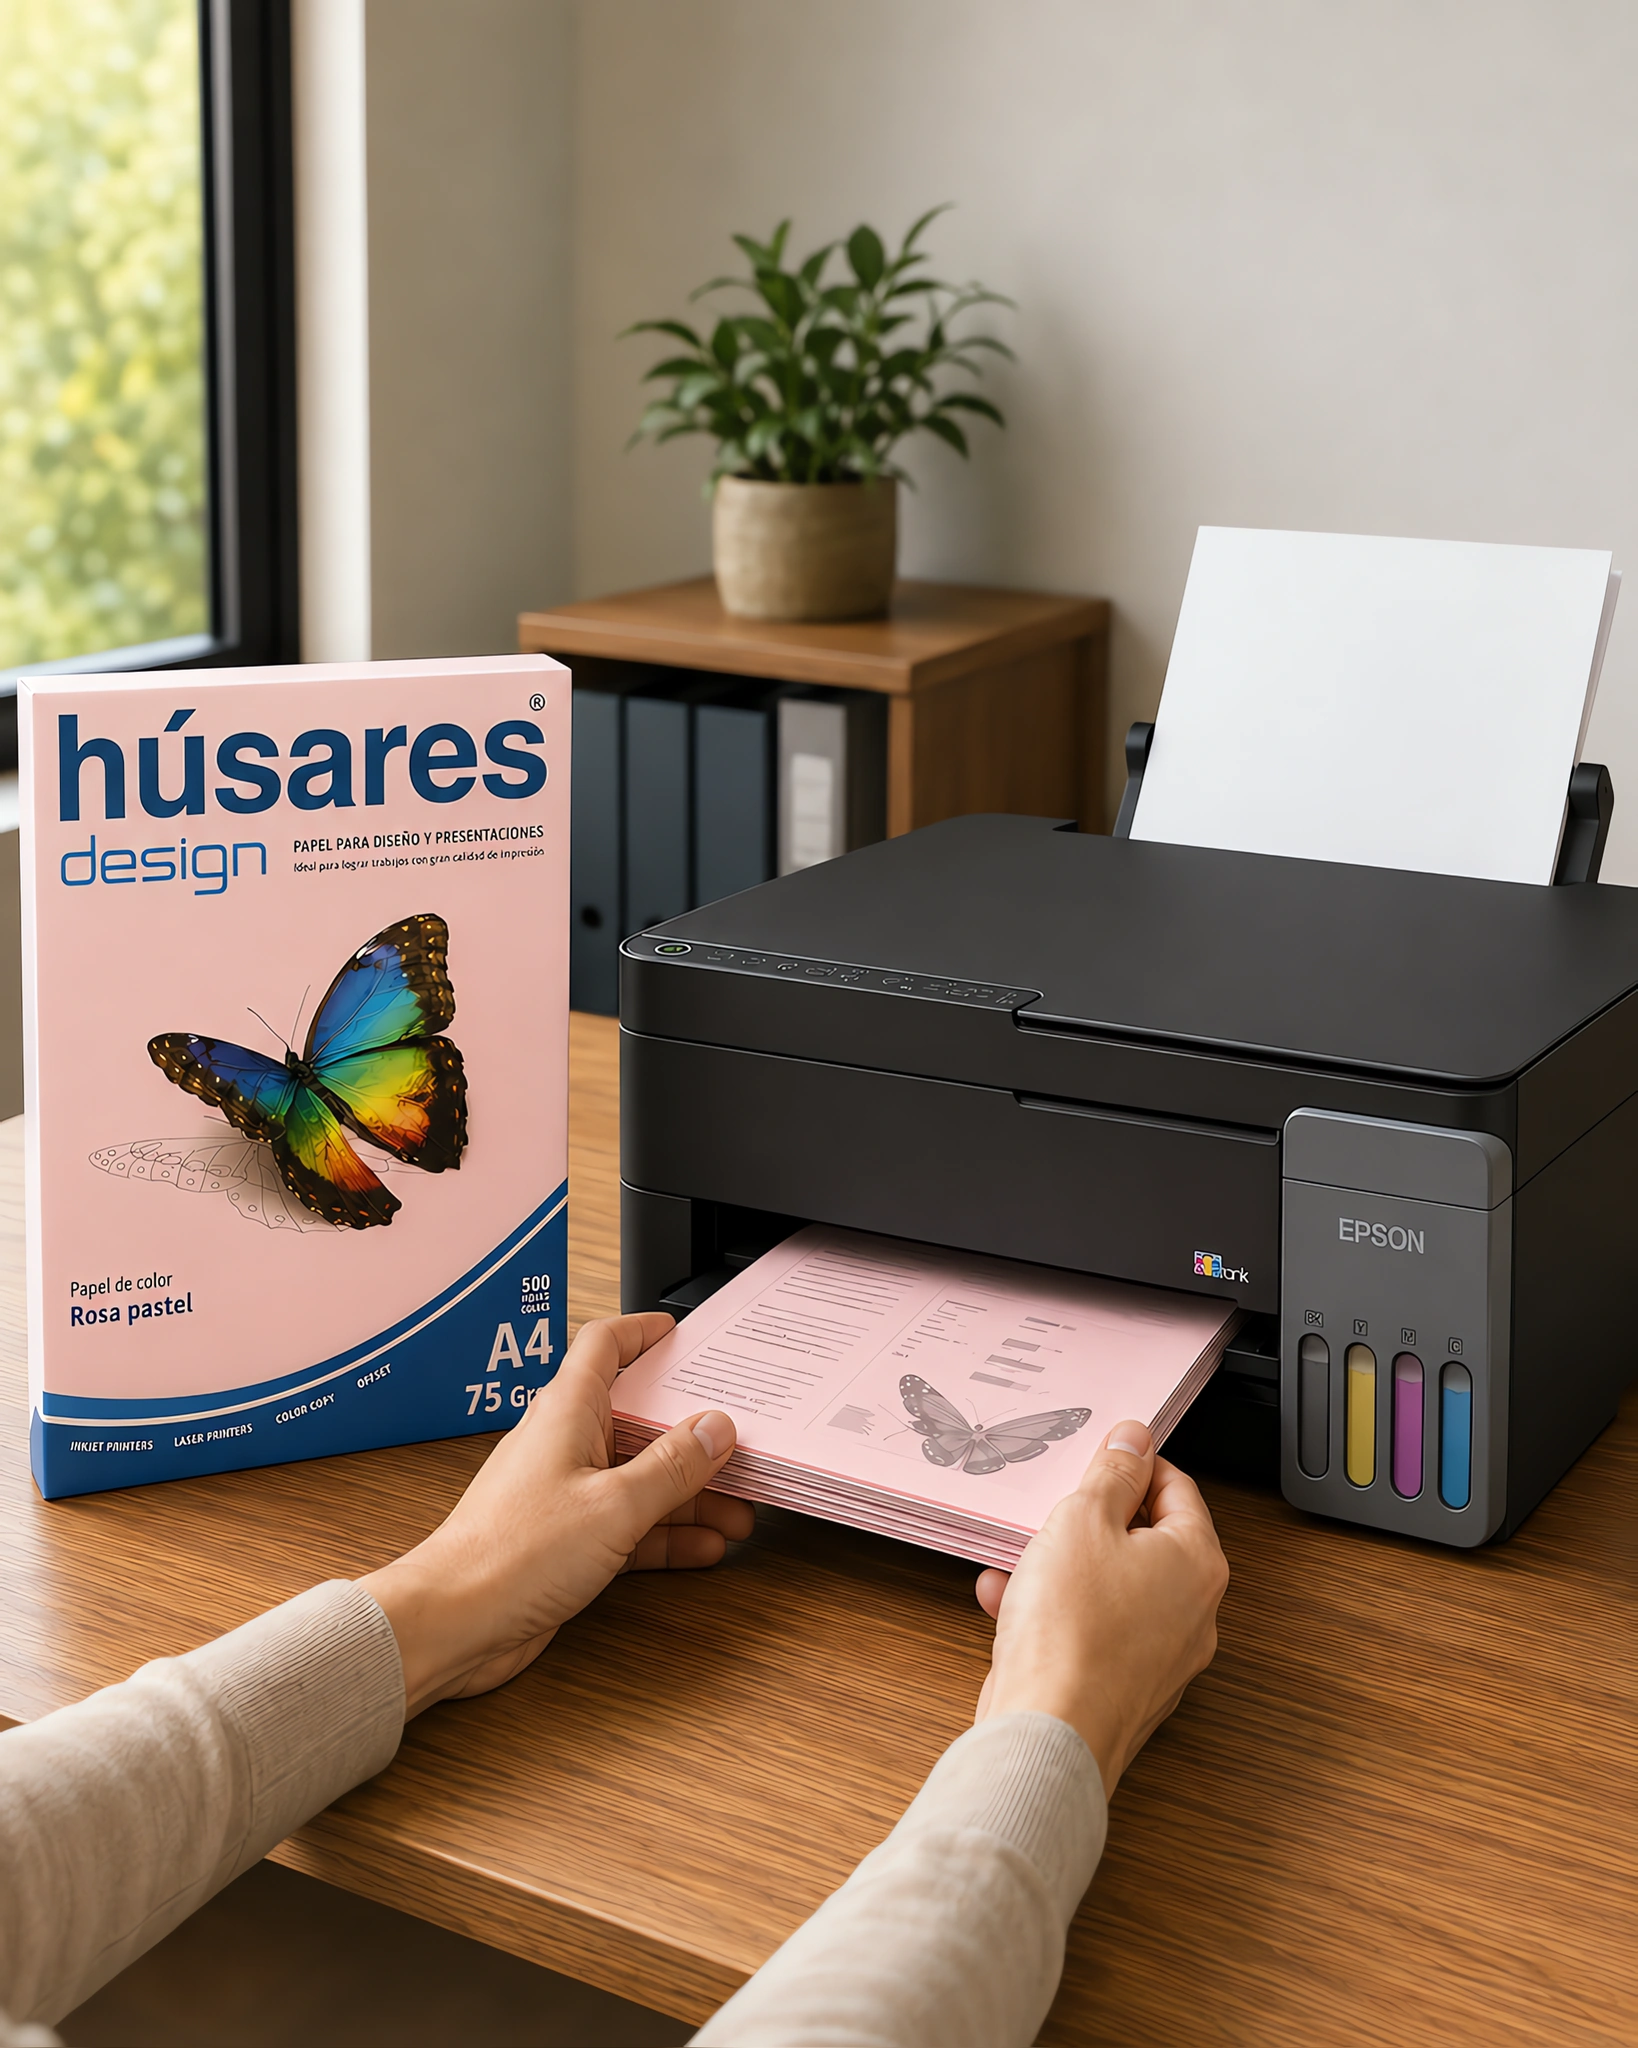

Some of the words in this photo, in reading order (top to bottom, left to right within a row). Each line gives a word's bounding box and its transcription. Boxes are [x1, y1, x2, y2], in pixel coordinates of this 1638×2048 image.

[57, 708, 548, 822] húsares
[293, 840, 333, 854] PAPEL
[336, 836, 370, 851] PARA
[373, 830, 420, 848] DISEÑO
[424, 832, 432, 845] Y
[435, 825, 544, 845] PRESENTACIONES
[60, 834, 267, 896] design
[1339, 1217, 1424, 1254] EPSON
[71, 1277, 110, 1300] Papel
[115, 1276, 132, 1292] de
[137, 1272, 173, 1290] color
[521, 1274, 550, 1293] 500
[71, 1306, 121, 1327] Rosa
[128, 1292, 193, 1326] pastel
[485, 1317, 553, 1372] A4
[275, 1405, 308, 1425] COLOR
[465, 1381, 503, 1416] 75
[510, 1385, 544, 1408] Gr
[174, 1433, 204, 1447] LASER
